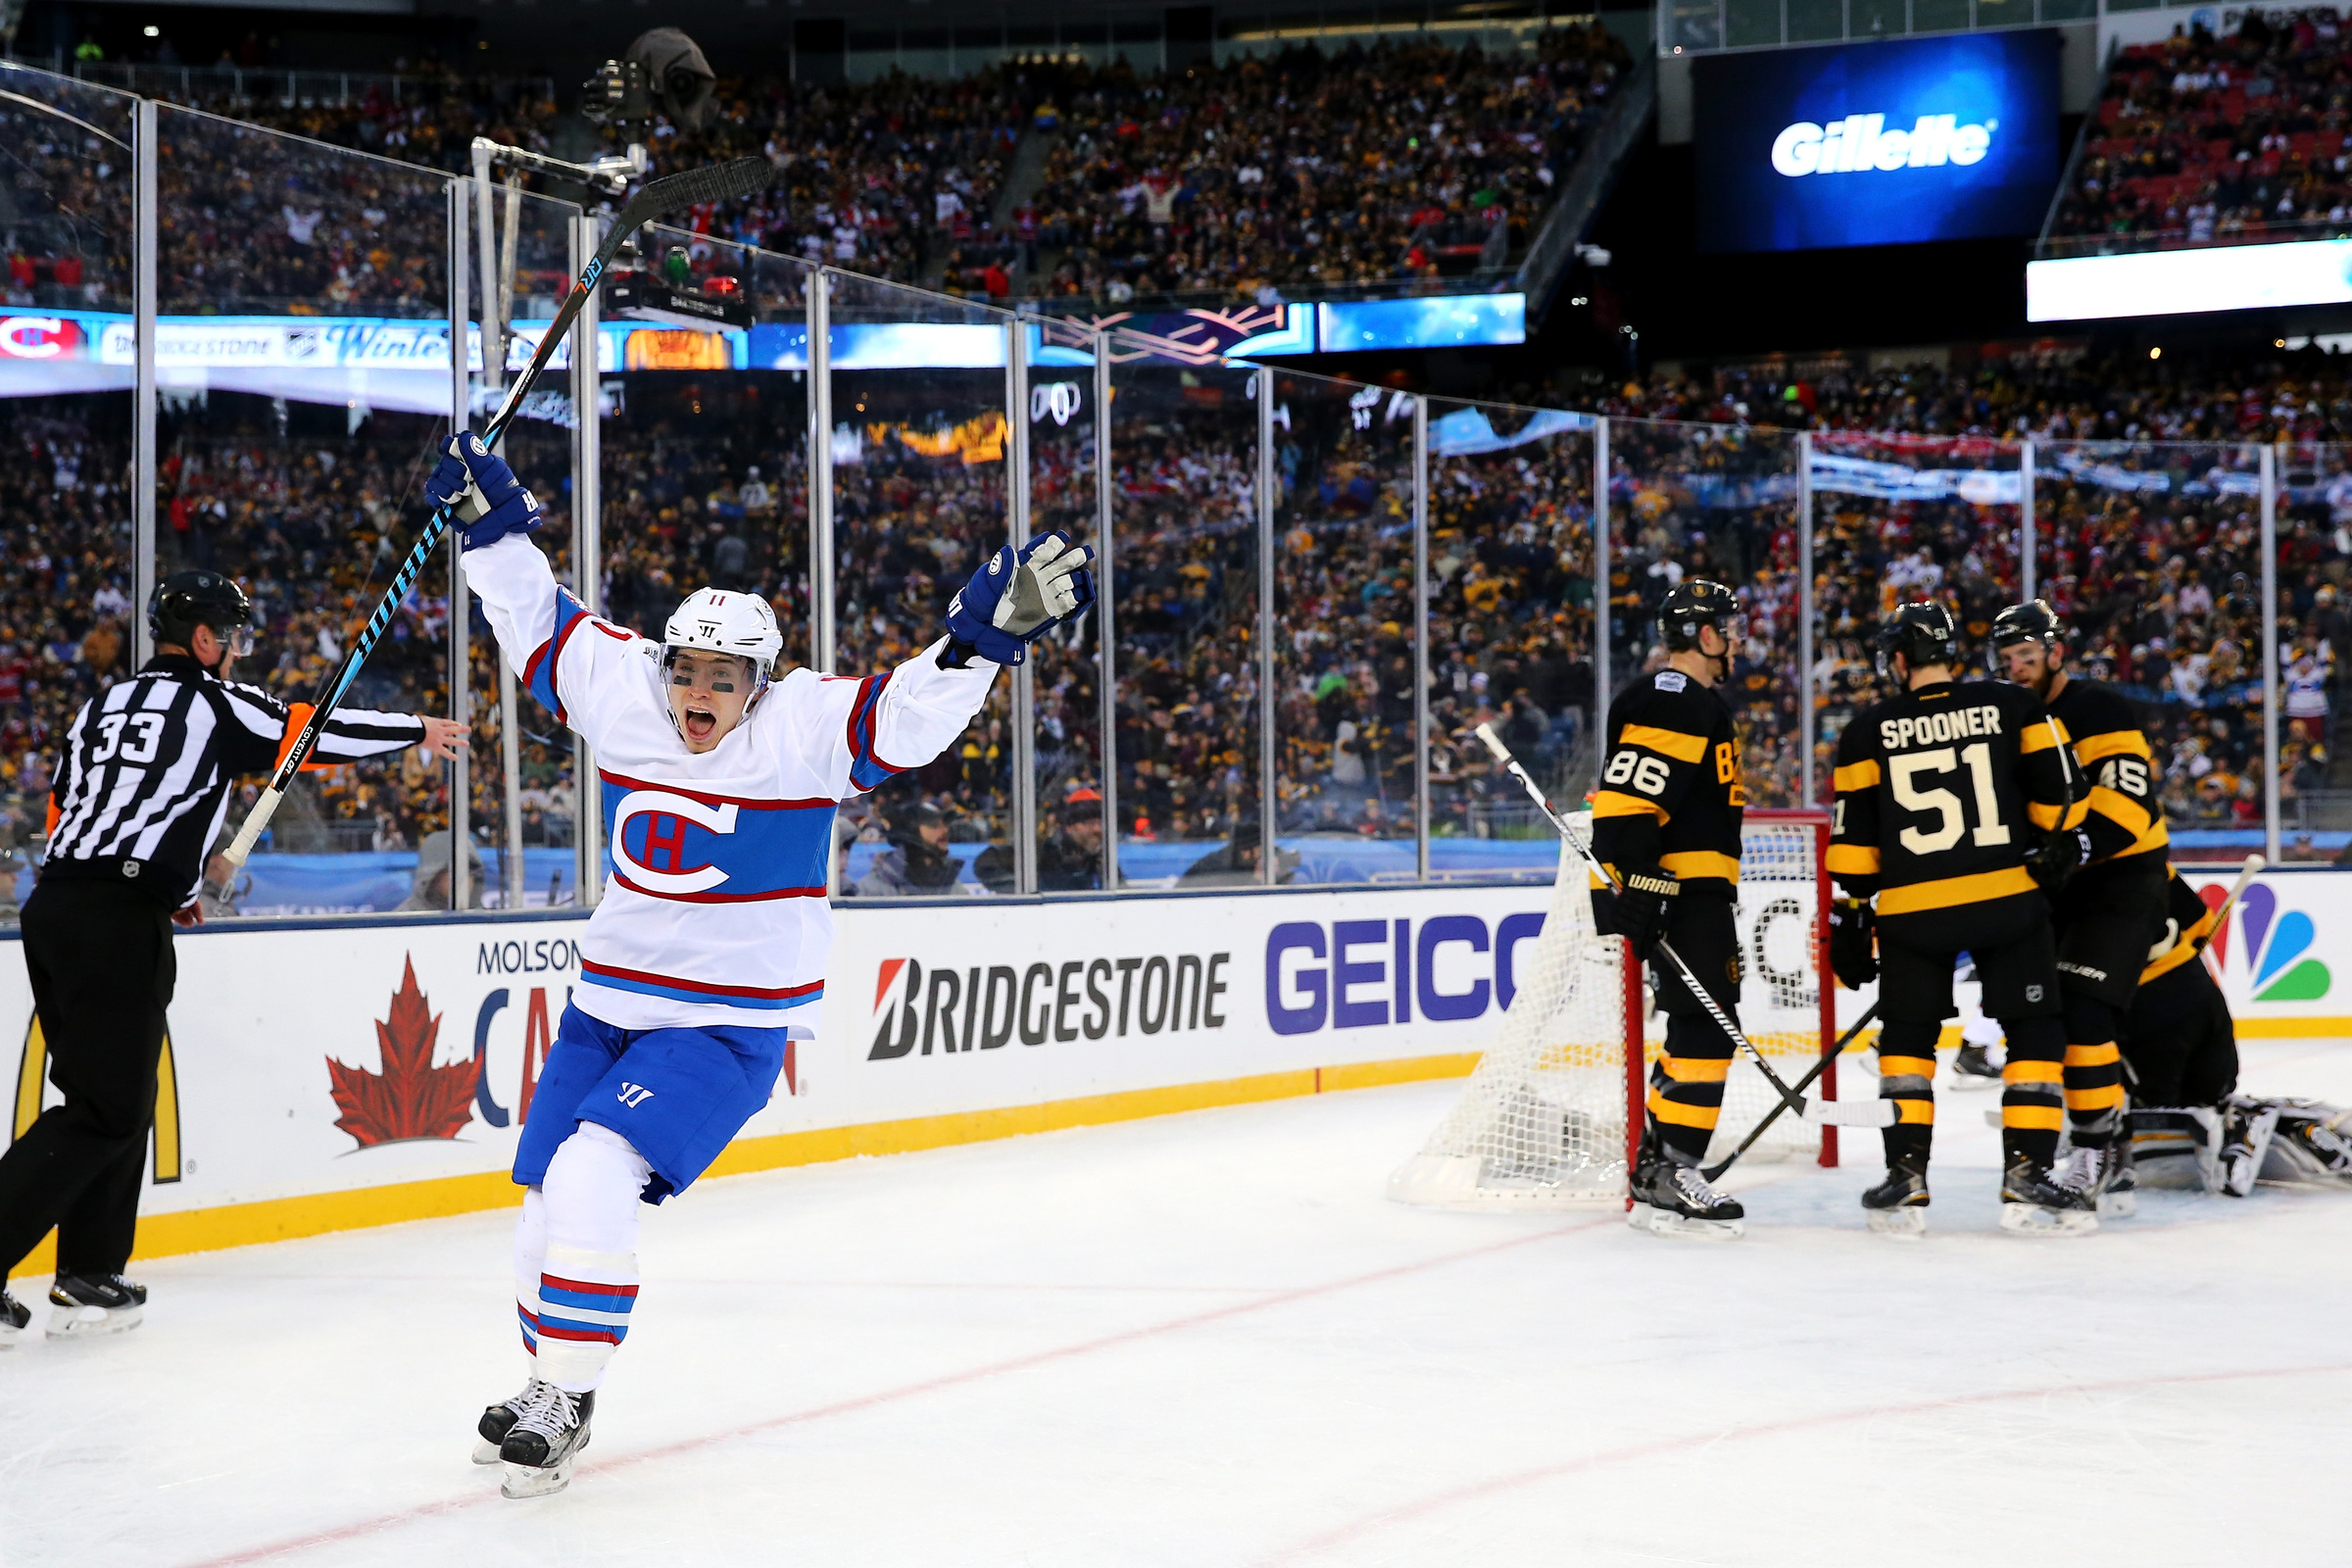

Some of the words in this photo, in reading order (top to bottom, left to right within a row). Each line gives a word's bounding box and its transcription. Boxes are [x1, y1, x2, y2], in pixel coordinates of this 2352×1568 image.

[1771, 113, 1990, 177] Gillette
[324, 324, 450, 363] Winte
[709, 594, 726, 607] 11
[92, 712, 166, 763] 33
[292, 725, 314, 761] COVERT
[1880, 705, 2002, 750] SPOONER
[1604, 751, 1671, 796] 86
[1888, 742, 2011, 856] 51
[1628, 873, 1681, 896] WARRI
[867, 952, 1231, 1061] BRIDGESTONE
